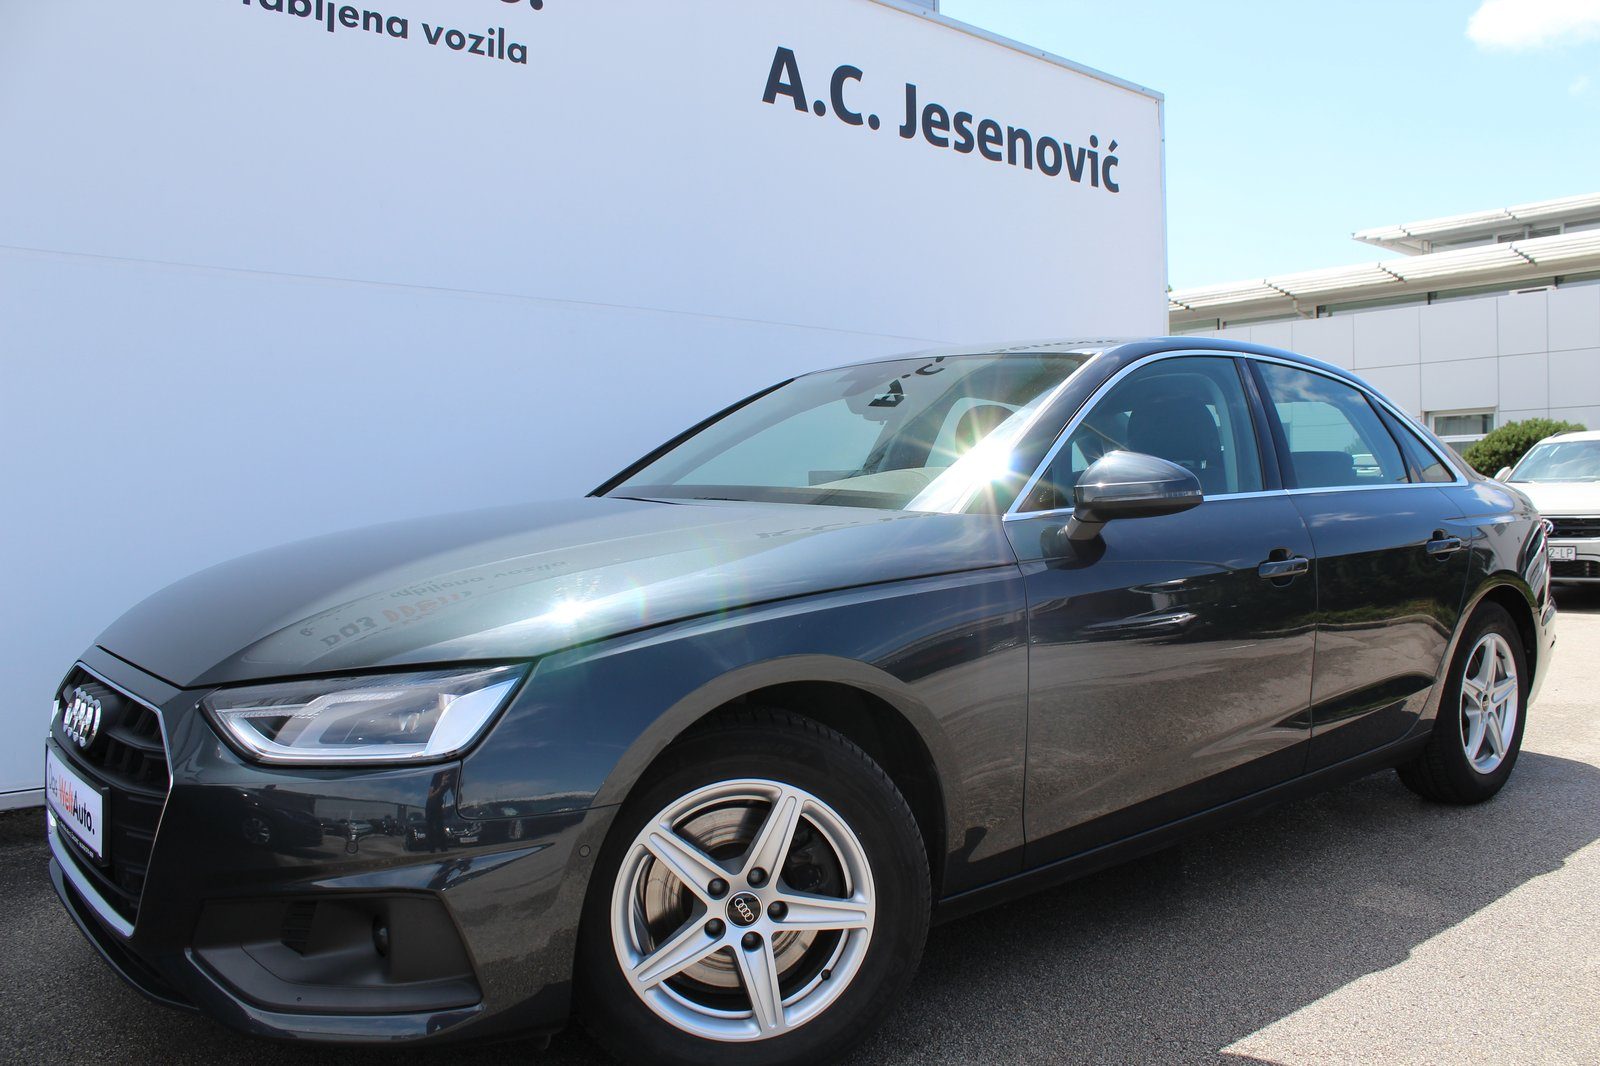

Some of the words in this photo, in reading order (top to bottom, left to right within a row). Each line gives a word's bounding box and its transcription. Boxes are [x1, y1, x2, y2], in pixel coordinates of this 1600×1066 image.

[243, 0, 408, 39] abljena
[422, 23, 527, 64] vozila
[762, 46, 880, 130] A.C.
[899, 82, 1119, 193] Jesenović
